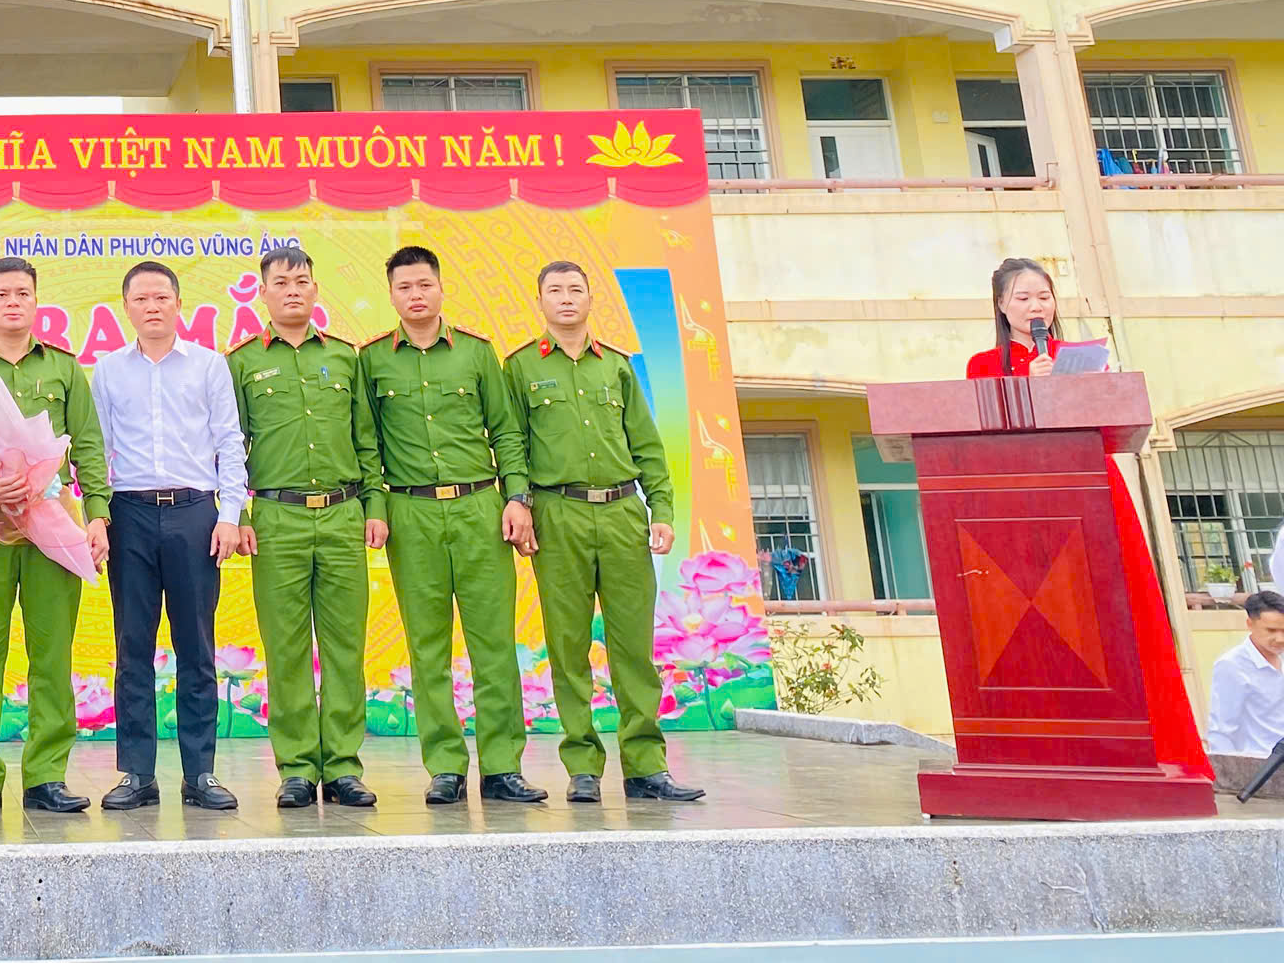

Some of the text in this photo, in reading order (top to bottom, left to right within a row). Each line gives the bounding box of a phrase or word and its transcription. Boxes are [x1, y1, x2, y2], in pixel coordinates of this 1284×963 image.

[70, 126, 171, 179] VIỆT
[183, 137, 285, 169] NAM
[296, 124, 428, 169] MUÔN
[440, 126, 545, 167] NĂM
[553, 133, 565, 167] !
[6, 234, 58, 256] NHÂN
[65, 234, 103, 256] DÂN
[111, 233, 194, 256] PHƯỜNG
[200, 233, 254, 256] VŨNG
